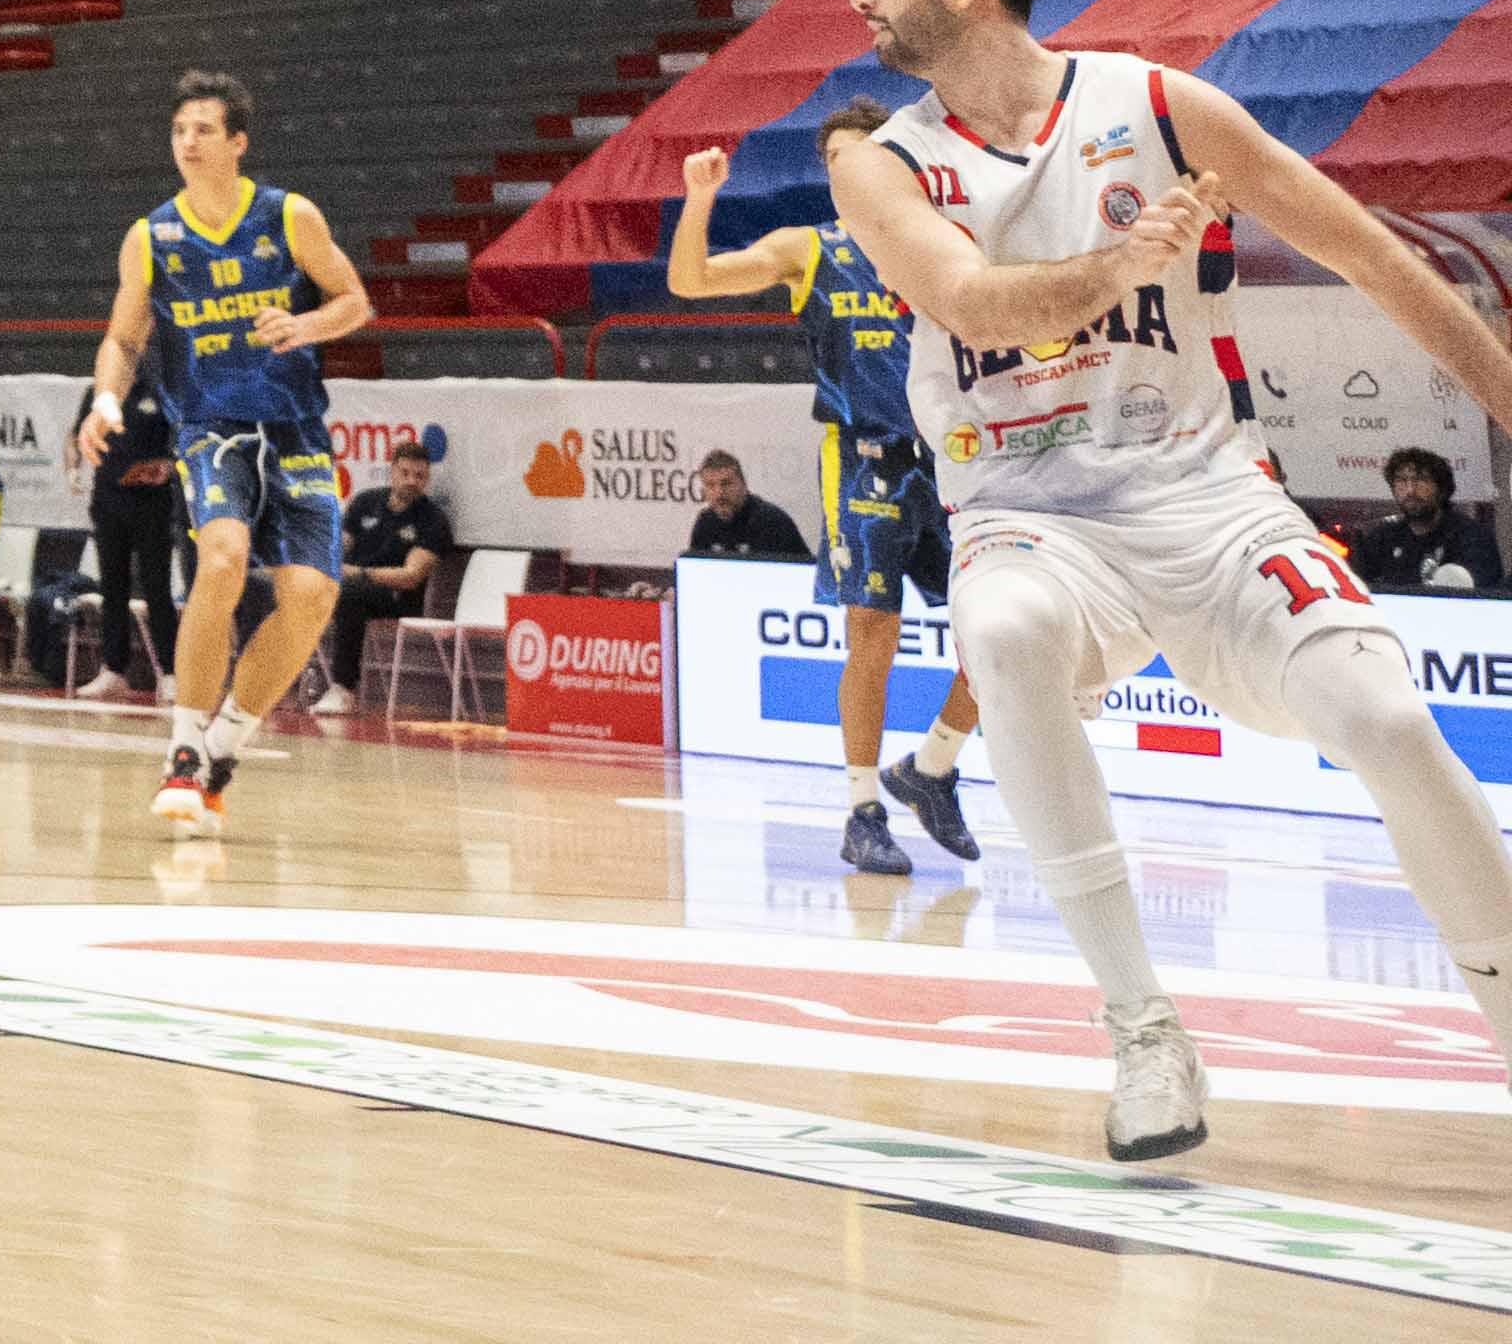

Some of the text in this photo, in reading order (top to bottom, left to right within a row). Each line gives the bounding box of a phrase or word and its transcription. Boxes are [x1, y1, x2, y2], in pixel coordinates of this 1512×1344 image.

[984, 400, 1093, 450] TECNICA
[1342, 416, 1389, 431] CLOUD
[1444, 417, 1457, 430] IA
[591, 429, 677, 463] SALUS
[1258, 546, 1374, 618] 11
[757, 605, 950, 662] CO.ET
[548, 633, 662, 679] DURING
[1103, 685, 1222, 718] olutio
